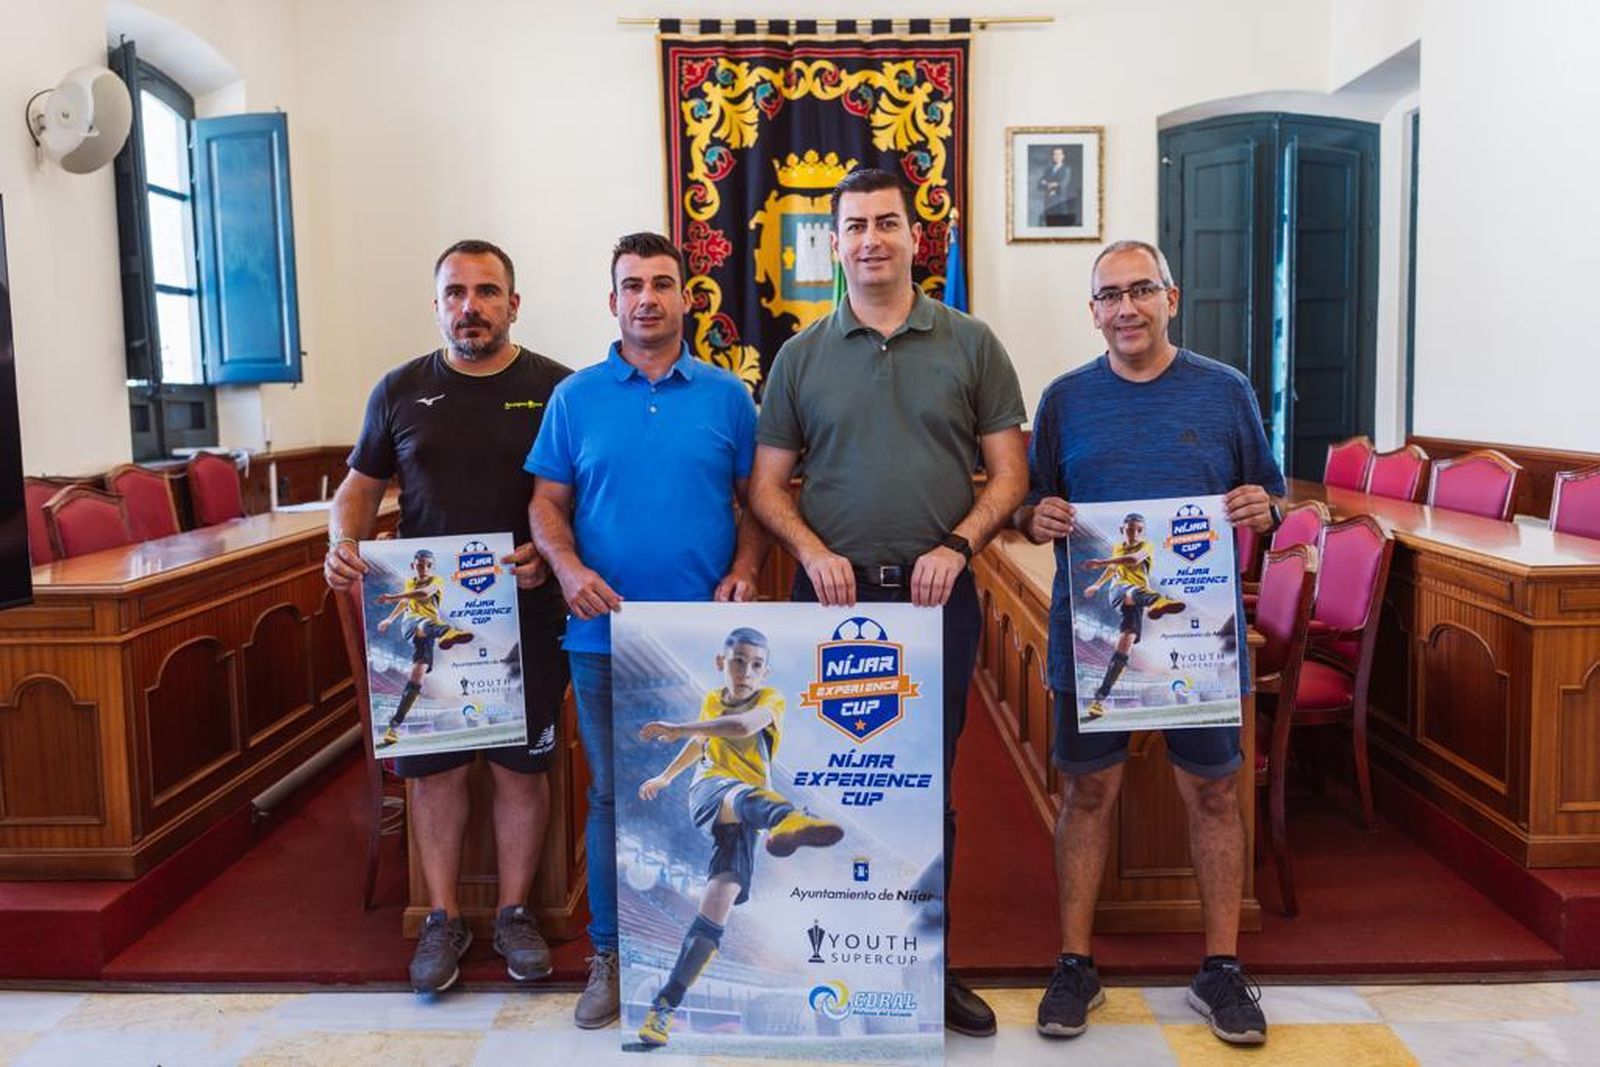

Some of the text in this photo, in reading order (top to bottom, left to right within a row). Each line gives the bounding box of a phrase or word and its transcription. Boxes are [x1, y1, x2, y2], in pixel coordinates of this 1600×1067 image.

[1181, 543, 1202, 552] CUP
[468, 576, 487, 586] CUP
[1160, 576, 1229, 586] EXPERIENCE
[1183, 585, 1205, 594] CUP
[449, 606, 512, 618] EXPERIENCE
[826, 654, 895, 676] NÍJAR
[816, 682, 900, 697] EXPERIENCE
[840, 700, 880, 716] CUP
[828, 749, 895, 769] NÍJAR
[793, 772, 932, 788] EXPERIENCE
[841, 792, 884, 806] CUP
[790, 887, 876, 903] Ayuntamiento
[878, 888, 894, 901] de
[828, 933, 918, 951] YOUTH
[831, 953, 918, 965] SUPERCUP
[853, 991, 917, 1010] CORAL
